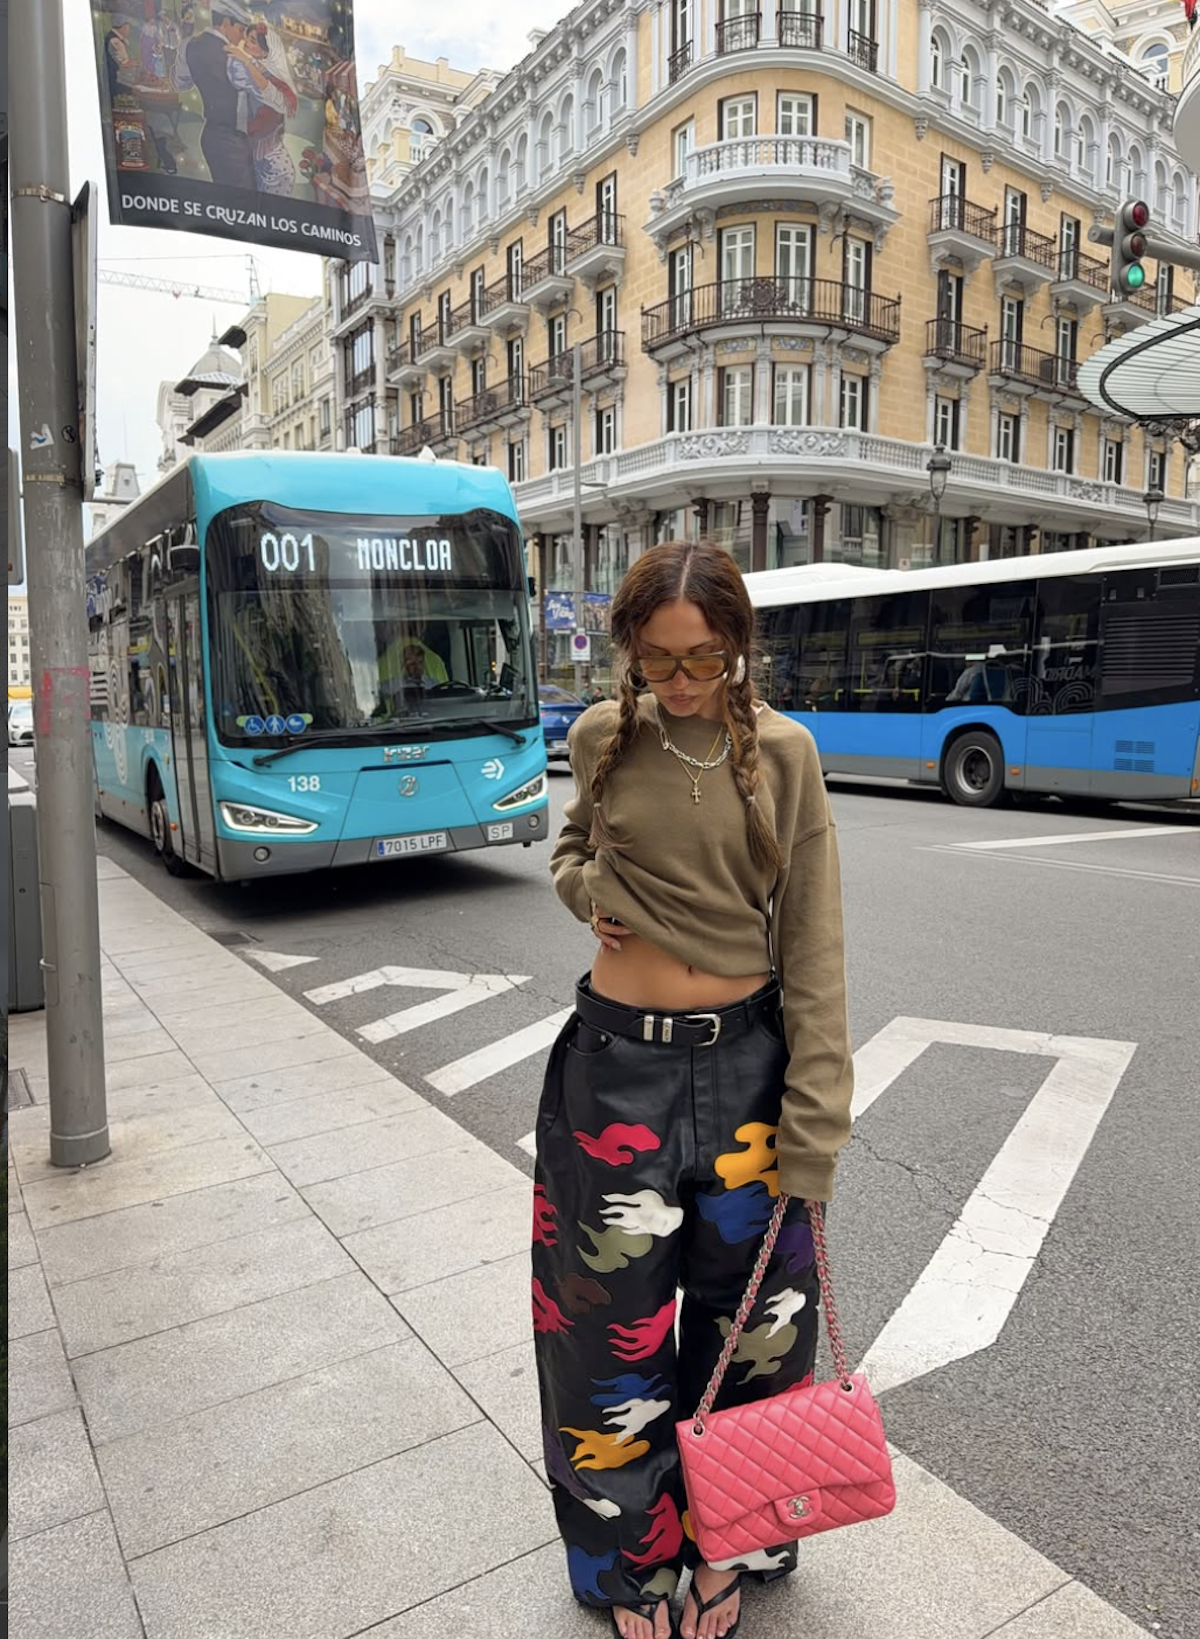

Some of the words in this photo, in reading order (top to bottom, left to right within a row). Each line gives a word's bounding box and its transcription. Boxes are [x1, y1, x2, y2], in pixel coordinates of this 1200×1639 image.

[121, 194, 180, 213] DONDE
[183, 201, 202, 216] SE
[205, 205, 267, 228] CRUZAN
[271, 216, 298, 234] LOS
[301, 223, 362, 247] CAMINOS
[260, 532, 316, 571] 001
[356, 538, 452, 570] MONCLOA
[287, 775, 321, 792] 138
[491, 826, 510, 839] SP
[386, 839, 418, 853] 7015
[420, 835, 443, 849] LPF
